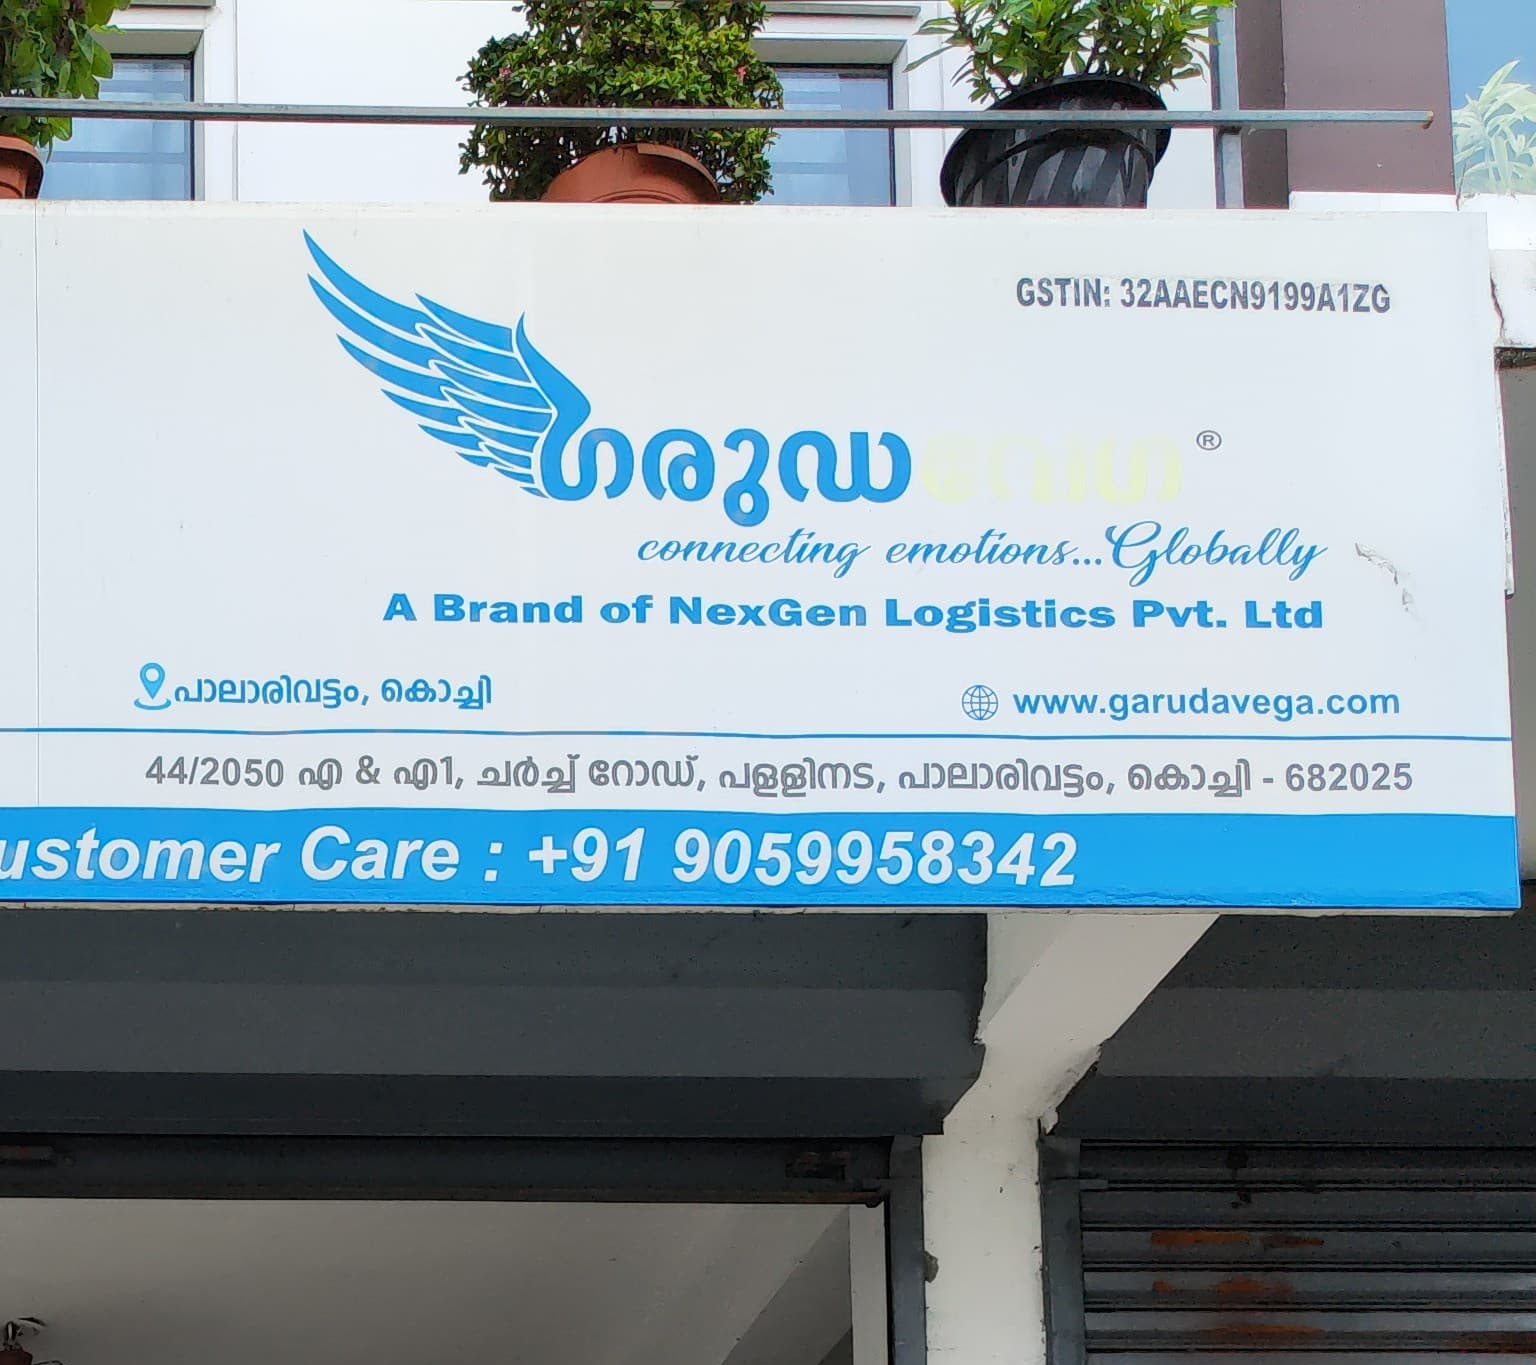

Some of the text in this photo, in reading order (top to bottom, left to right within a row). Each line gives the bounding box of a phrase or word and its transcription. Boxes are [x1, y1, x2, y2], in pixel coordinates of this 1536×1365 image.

[1018, 279, 1390, 314] GSTIN: 32AAECN9199A1ZG
[637, 527, 871, 579] connecting
[385, 594, 1324, 635] A Brand of NexGen Logistics Pvt. Ltd
[175, 675, 493, 711] പാലാരിവട്ടം, കൊച്ചി
[1013, 687, 1401, 721] www.garudavega.com
[147, 757, 284, 788] 44/2050
[300, 760, 343, 791] എ
[357, 756, 381, 785] &
[900, 760, 1113, 798] പാലാരിവട്ടം,
[1129, 760, 1251, 798] കൊച്ചി
[1287, 764, 1413, 792] 682025
[300, 825, 460, 882] Care
[527, 827, 648, 883] +91
[672, 828, 1079, 887] 9059958342
